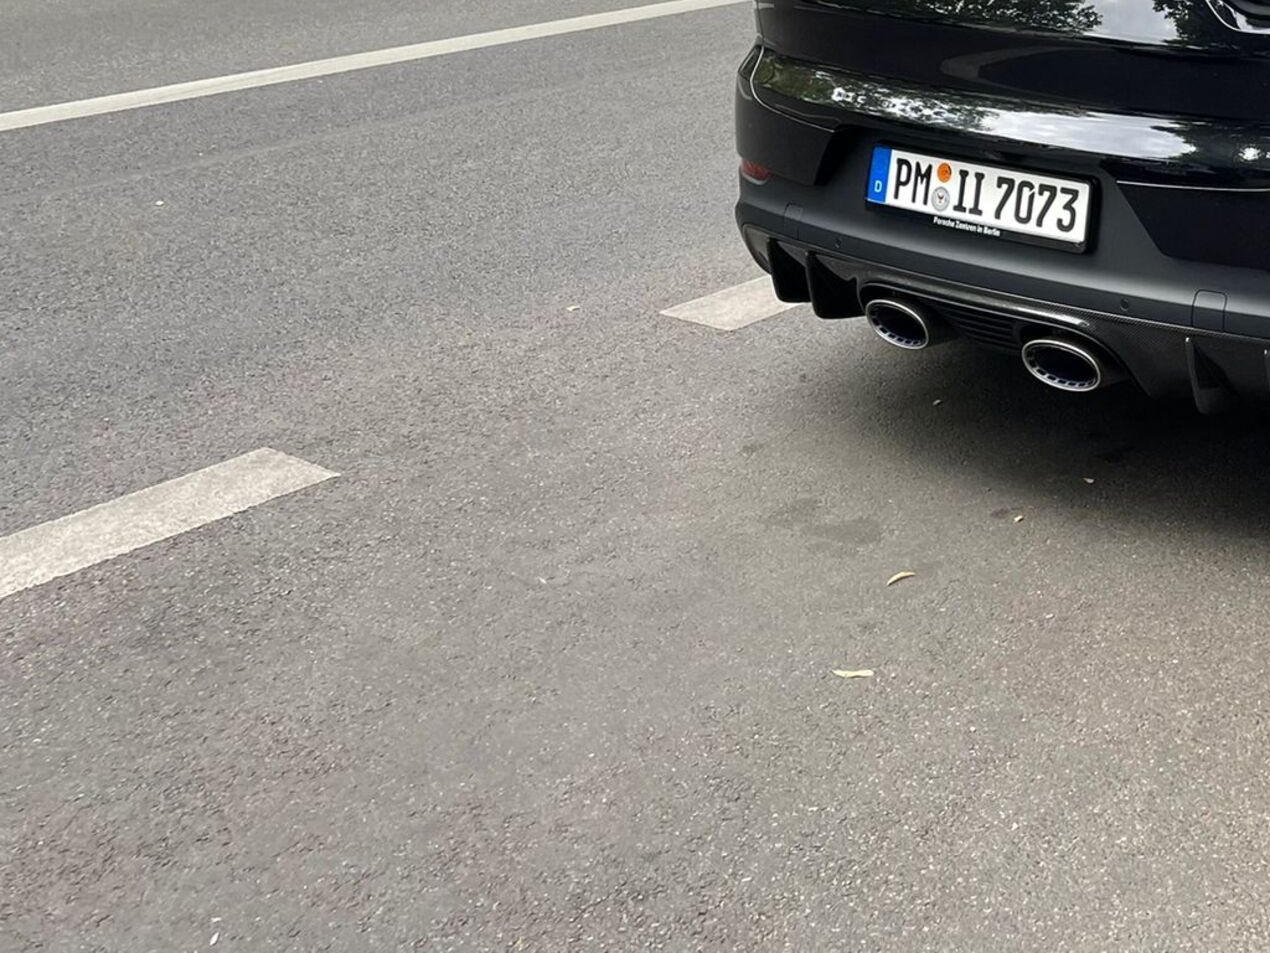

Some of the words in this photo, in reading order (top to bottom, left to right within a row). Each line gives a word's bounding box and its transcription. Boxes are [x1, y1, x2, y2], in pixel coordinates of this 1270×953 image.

[874, 179, 882, 193] D
[893, 157, 934, 206] PM
[953, 169, 985, 216] II
[994, 176, 1080, 233] 7073
[933, 216, 955, 228] Porsche
[955, 220, 977, 232] Zentren
[983, 226, 1001, 237] Berlin
